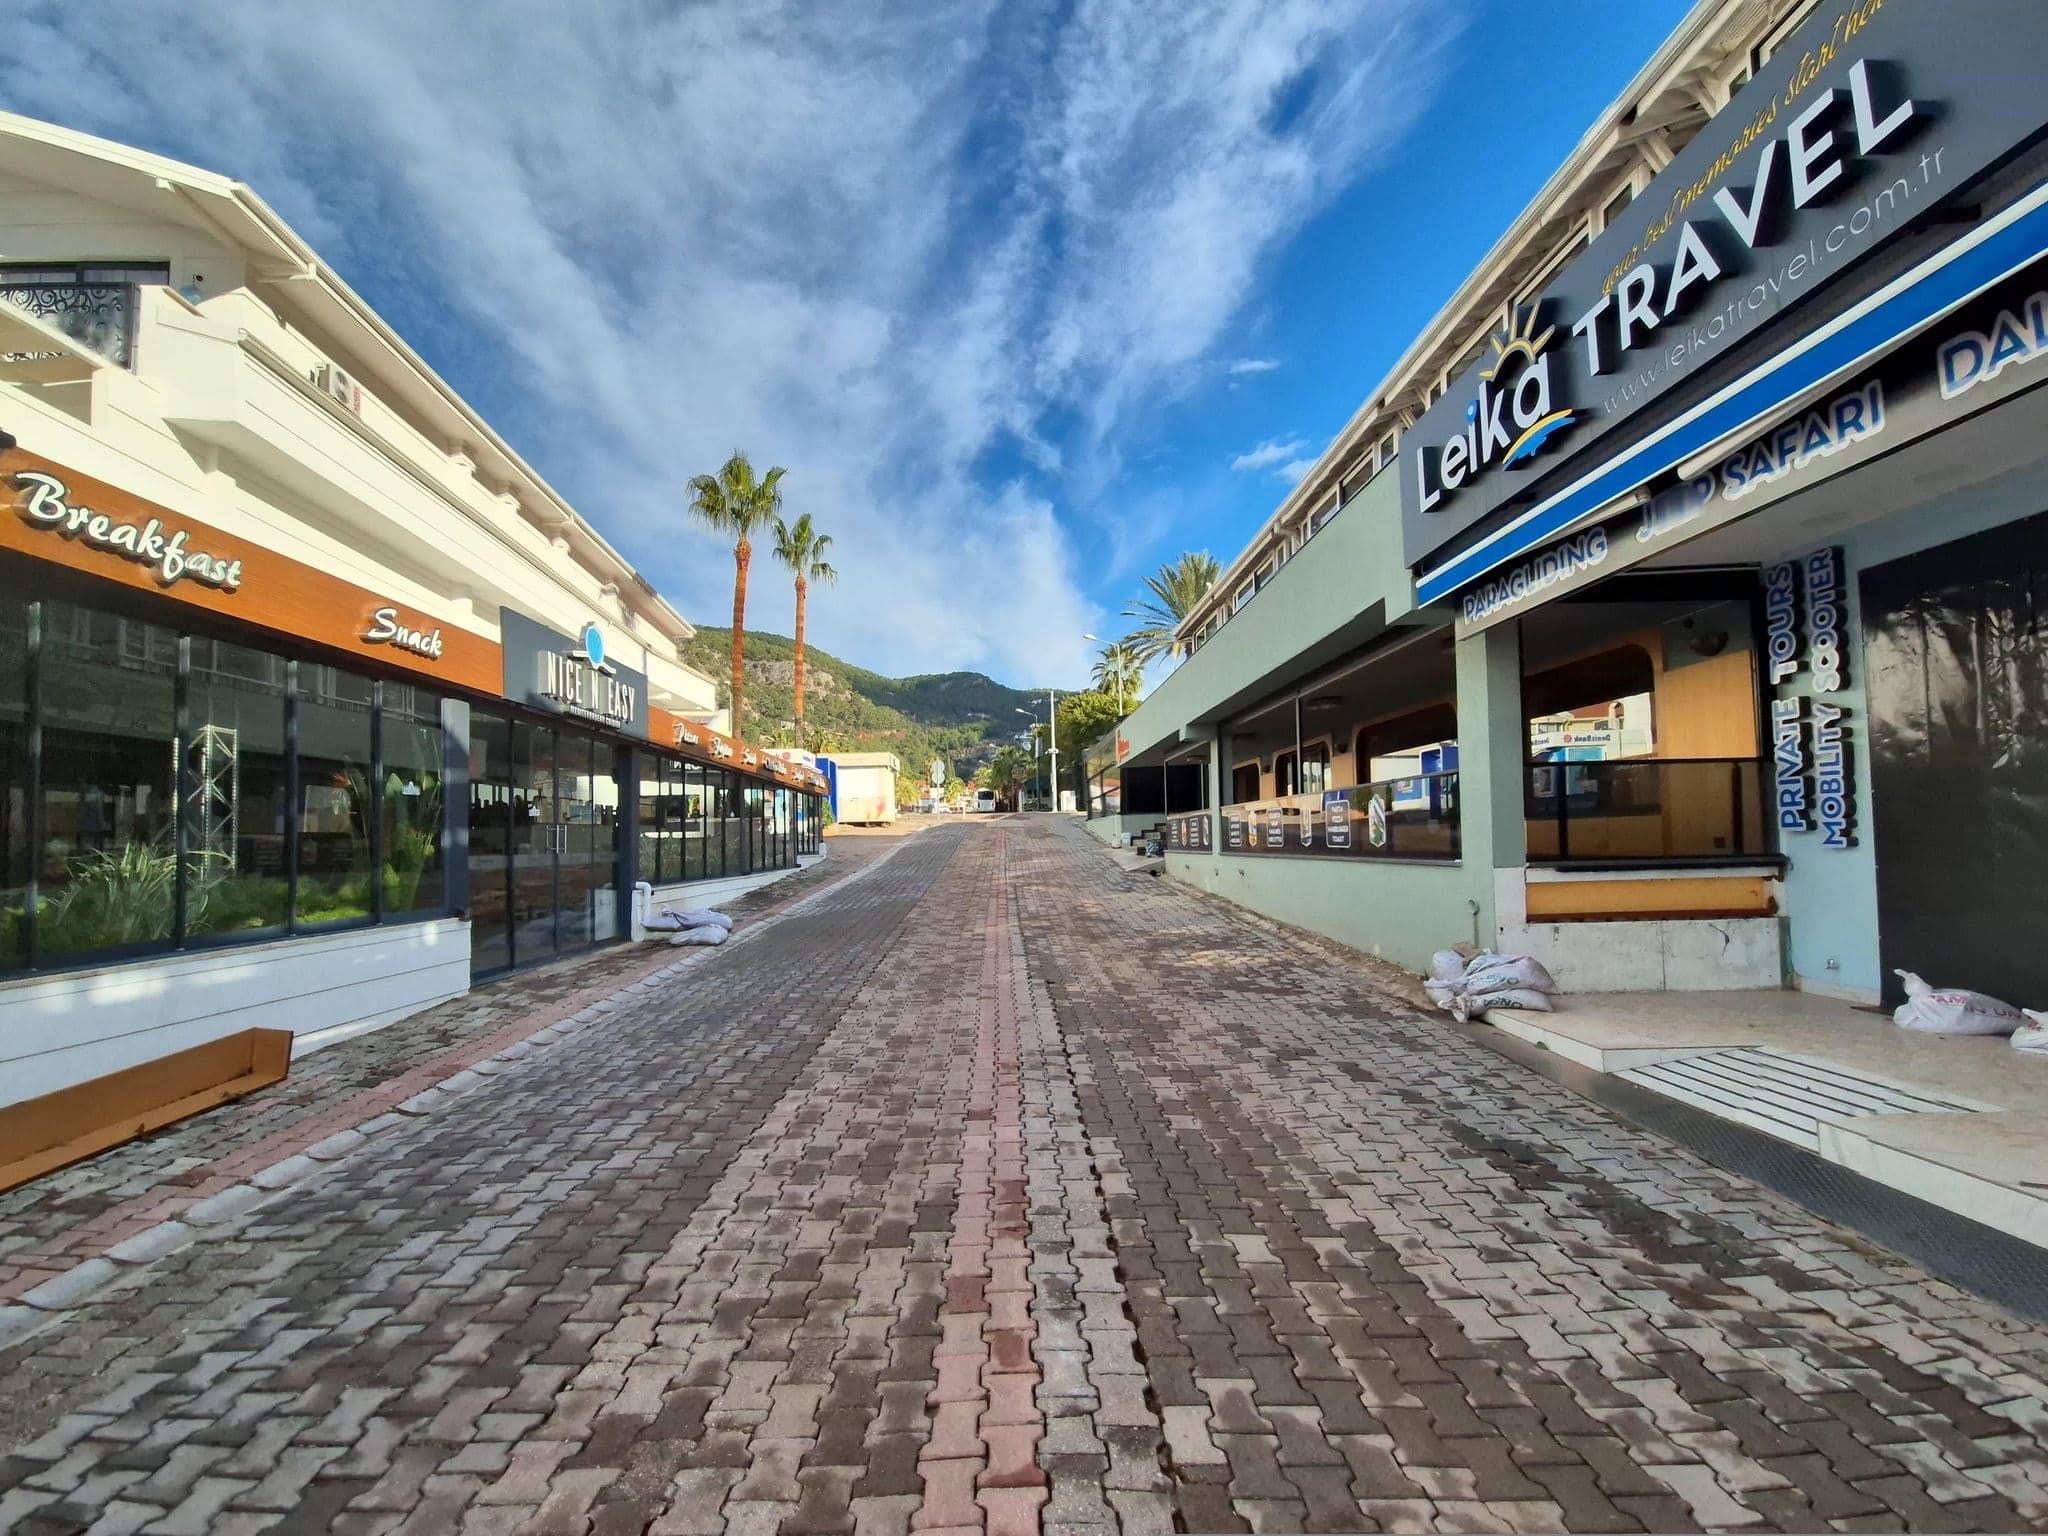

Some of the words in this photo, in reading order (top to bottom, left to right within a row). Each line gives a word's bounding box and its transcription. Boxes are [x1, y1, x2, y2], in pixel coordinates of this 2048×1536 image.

[1643, 189, 1681, 251] best
[1680, 93, 1777, 213] memories
[1784, 13, 1845, 105] start
[1416, 352, 1552, 513] Leika
[1572, 58, 1914, 376] TRAVEL
[1603, 146, 1944, 413] www.leikatravel.com.tr
[15, 472, 242, 583] Breakfast
[1463, 526, 1609, 624] PARAGLIDING
[1636, 471, 1716, 543] JP
[1722, 379, 1885, 501] SAFARI
[367, 608, 442, 656] Snack
[547, 650, 583, 704] NICE
[608, 677, 635, 722] EASY
[1767, 562, 1798, 685] TOURS
[1808, 547, 1841, 692] SCOOTER
[1772, 696, 1805, 831] PRIVATE
[1812, 703, 1847, 849] MOBILITY
